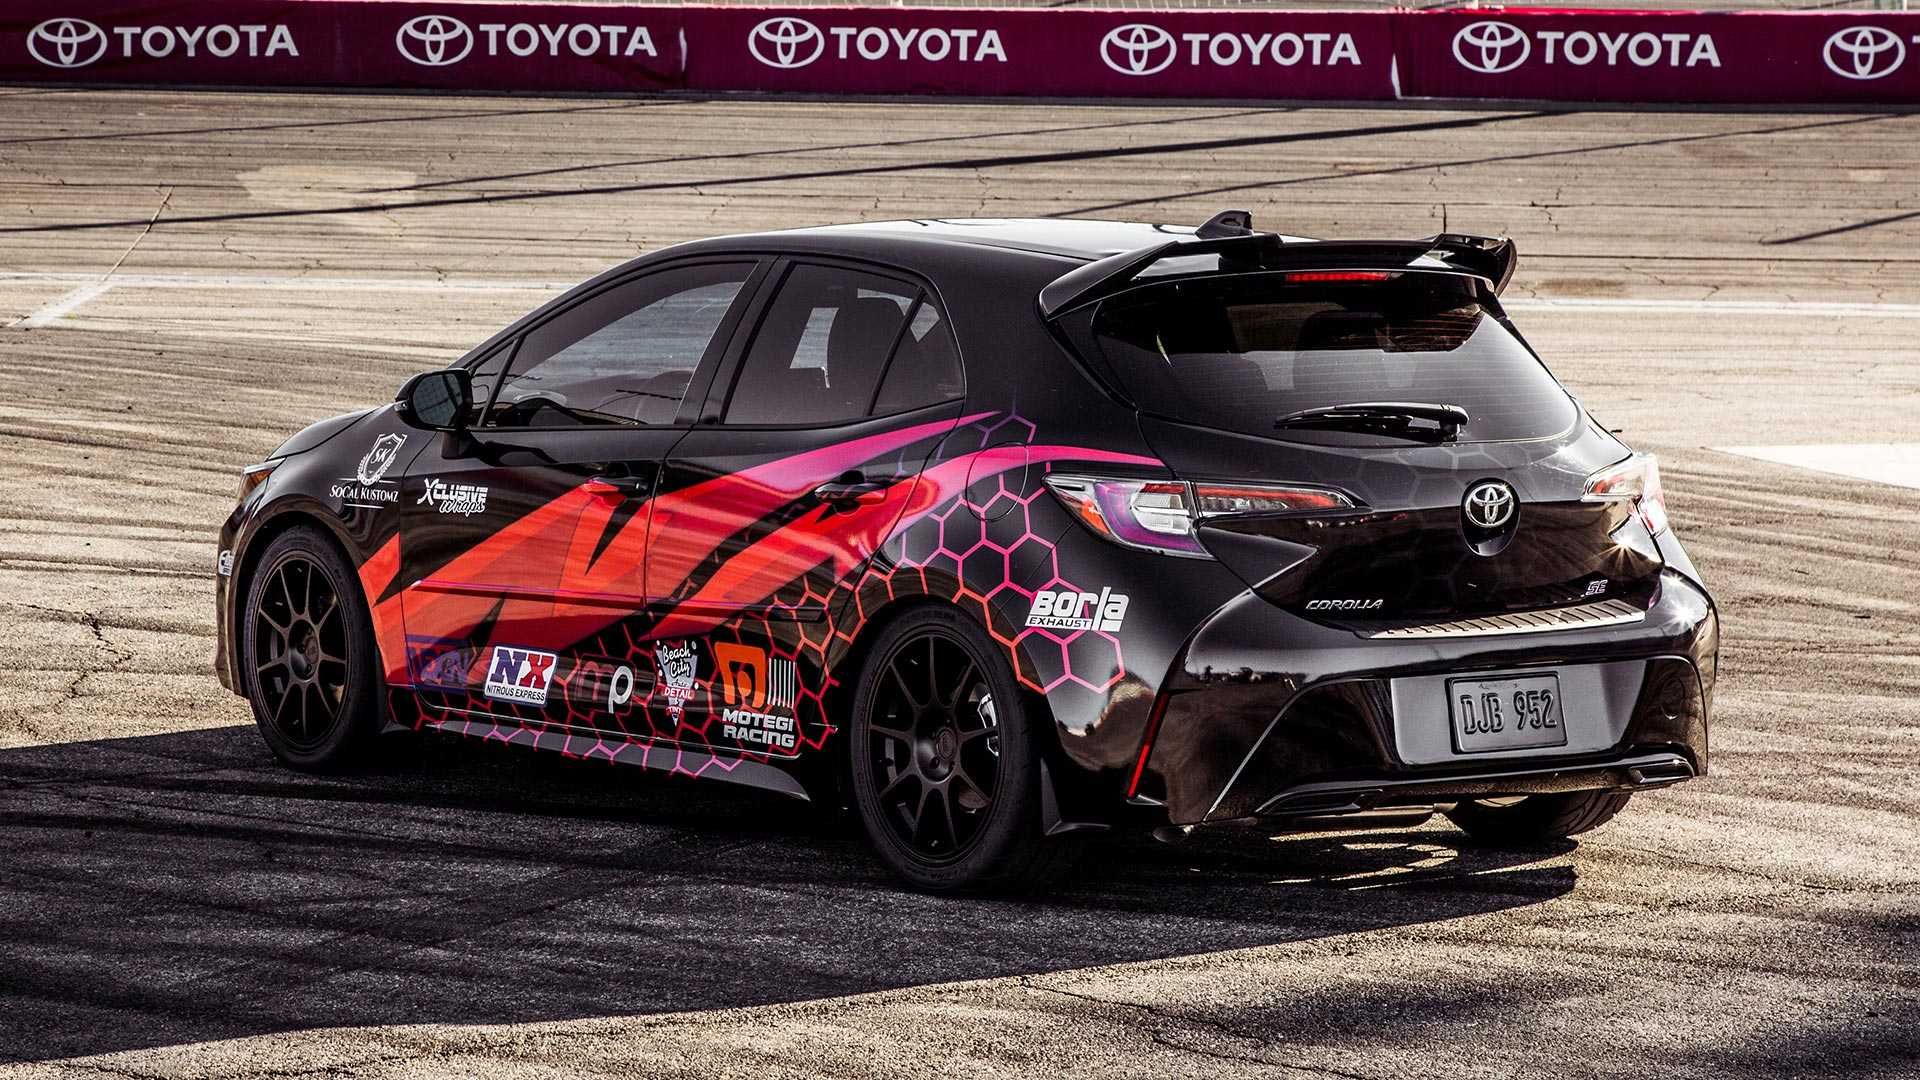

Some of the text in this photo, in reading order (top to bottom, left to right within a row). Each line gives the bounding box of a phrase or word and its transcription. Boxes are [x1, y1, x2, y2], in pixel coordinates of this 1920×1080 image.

[114, 25, 299, 58] TOYOTA
[479, 23, 658, 58] TOYOTA
[831, 27, 1008, 64] TOYOTA
[1183, 32, 1361, 67] TOYOTA
[1537, 31, 1721, 69] TOYOTA
[373, 448, 388, 463] SK
[1586, 579, 1608, 595] SE
[1305, 598, 1384, 611] COROLLA
[1029, 616, 1090, 629] EXHAUST
[662, 640, 690, 663] Beach
[490, 650, 554, 689] NX
[670, 658, 690, 678] City
[486, 687, 546, 702] NITROUS EXPRESS
[664, 687, 692, 700] DETAIL
[722, 709, 794, 731] MOTEGI
[1459, 689, 1558, 736] DJB 952
